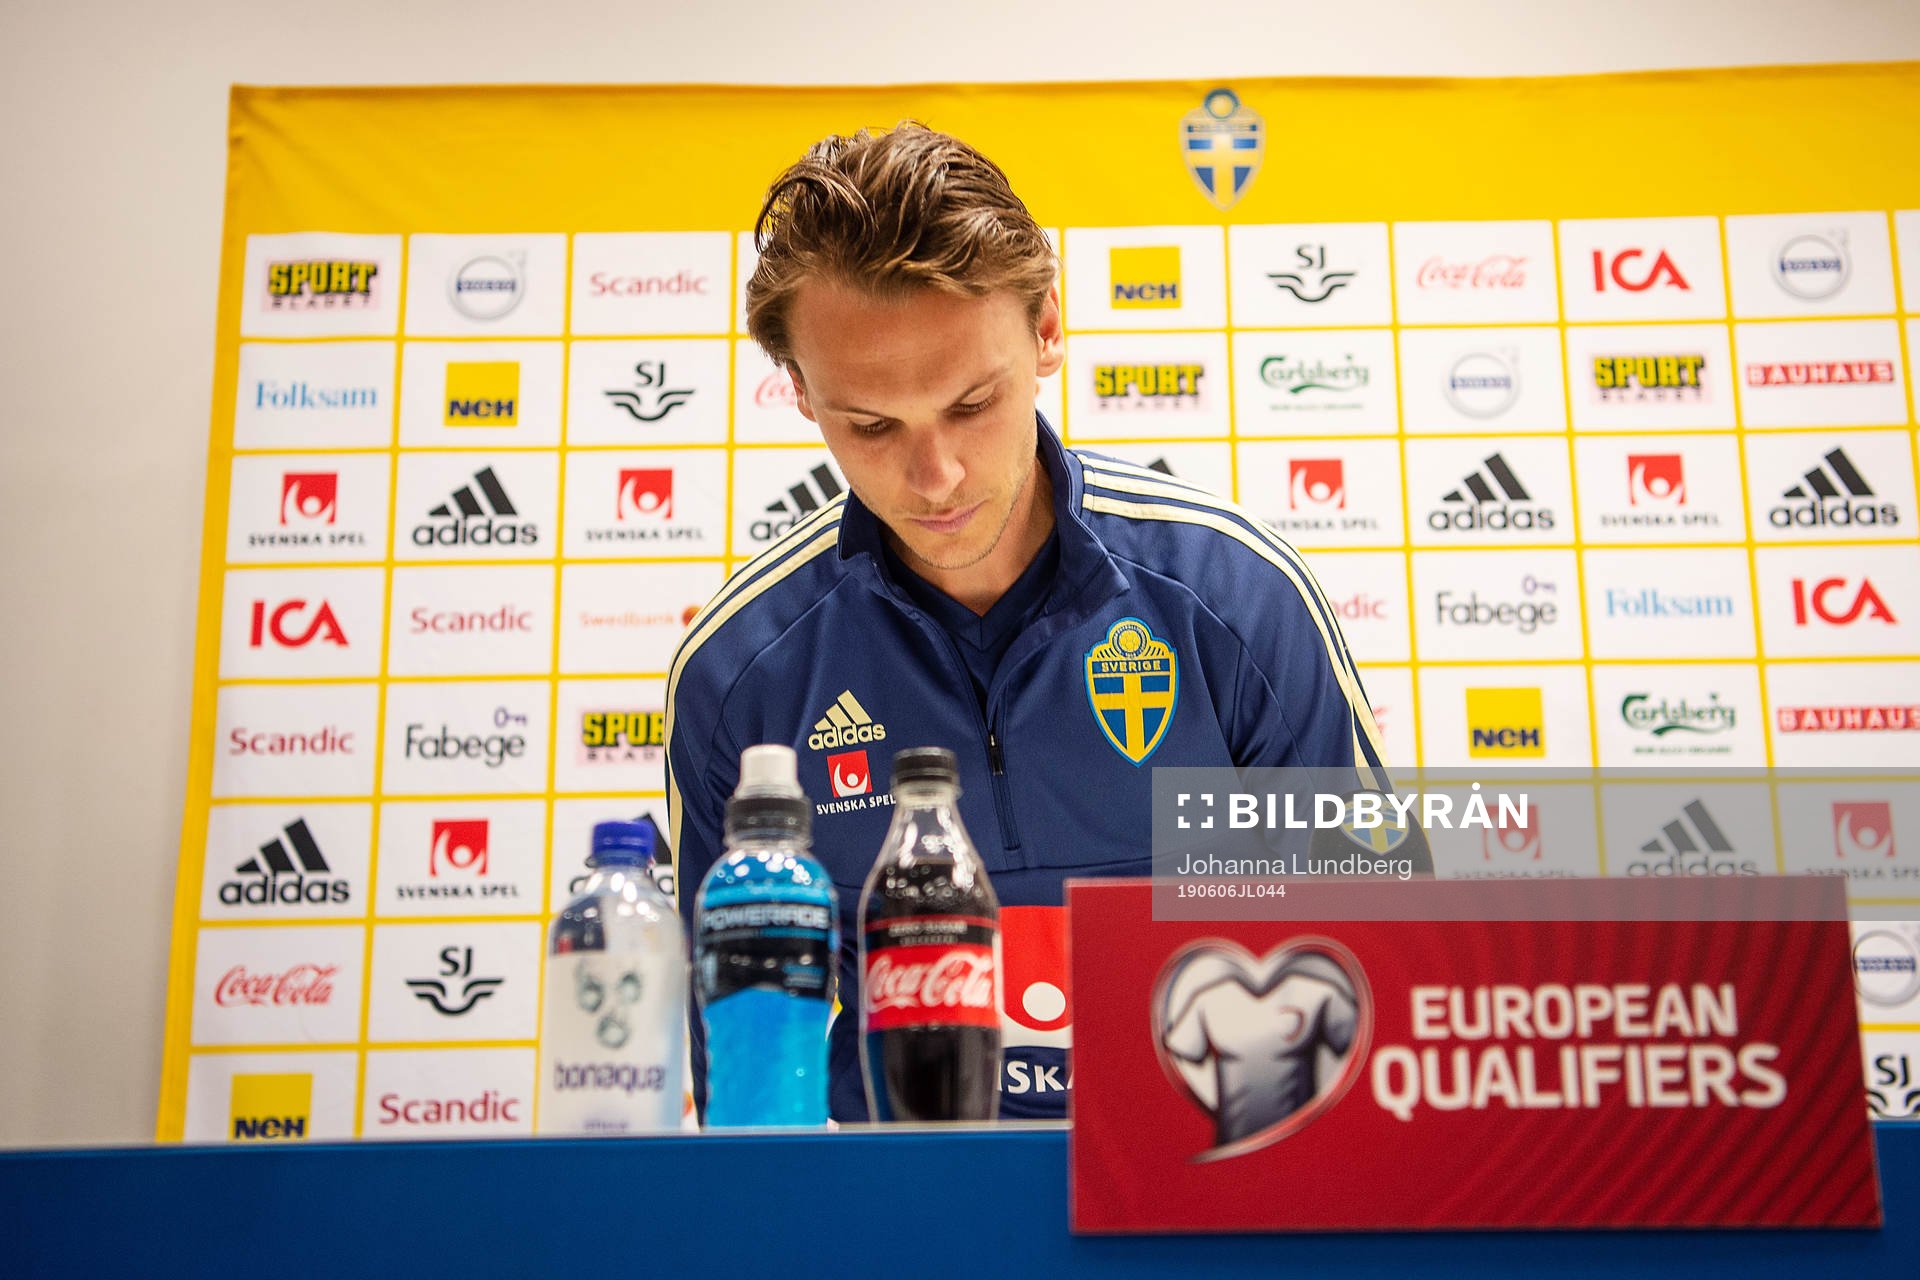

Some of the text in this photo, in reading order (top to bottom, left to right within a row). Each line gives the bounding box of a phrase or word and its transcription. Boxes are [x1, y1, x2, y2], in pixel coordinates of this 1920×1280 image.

[1296, 244, 1326, 269] SJ
[1592, 249, 1691, 292] ICA
[267, 261, 378, 298] SPORT
[590, 270, 709, 297] Scandic
[1114, 282, 1178, 300] NCH
[635, 361, 666, 387] SJ
[1095, 363, 1204, 398] SPORT
[1260, 353, 1369, 393] Carlsberg
[1594, 355, 1705, 389] SPORT
[1748, 362, 1893, 385] BAUHAUS
[256, 381, 378, 410] Folksam
[449, 400, 515, 418] NCH
[1342, 517, 1379, 530] SPEL
[1428, 500, 1555, 531] adidas
[1600, 513, 1720, 527] SVENSKA SPEL
[1769, 498, 1899, 529] adidas
[249, 532, 367, 547] SVENSKA SPEL
[413, 514, 538, 548] adidas
[586, 526, 704, 541] SVENSKA SPEL
[1436, 590, 1557, 633] Fabege
[1606, 588, 1734, 617] Folksam
[1792, 577, 1897, 627] ICA
[250, 599, 349, 648] ICA
[410, 606, 533, 633] Scandic
[1101, 660, 1161, 673] SVERIGE
[1621, 692, 1737, 737] Carlsberg
[229, 727, 355, 756] Scandic
[582, 711, 665, 748] SPOR
[808, 722, 887, 751] adidas
[1472, 728, 1540, 750] NCH
[405, 724, 526, 768] Fabege
[816, 795, 897, 815] SVENSKA SPEL
[1626, 853, 1759, 877] adidas
[218, 870, 350, 906] adidas
[397, 884, 520, 898] SVENSKA SPEL
[439, 947, 474, 977] SJ
[1411, 984, 1739, 1041] EUROPEAN
[1371, 1043, 1788, 1121] QUALIFIERS
[1875, 1054, 1911, 1088] SJ
[379, 1091, 520, 1126] Scandic
